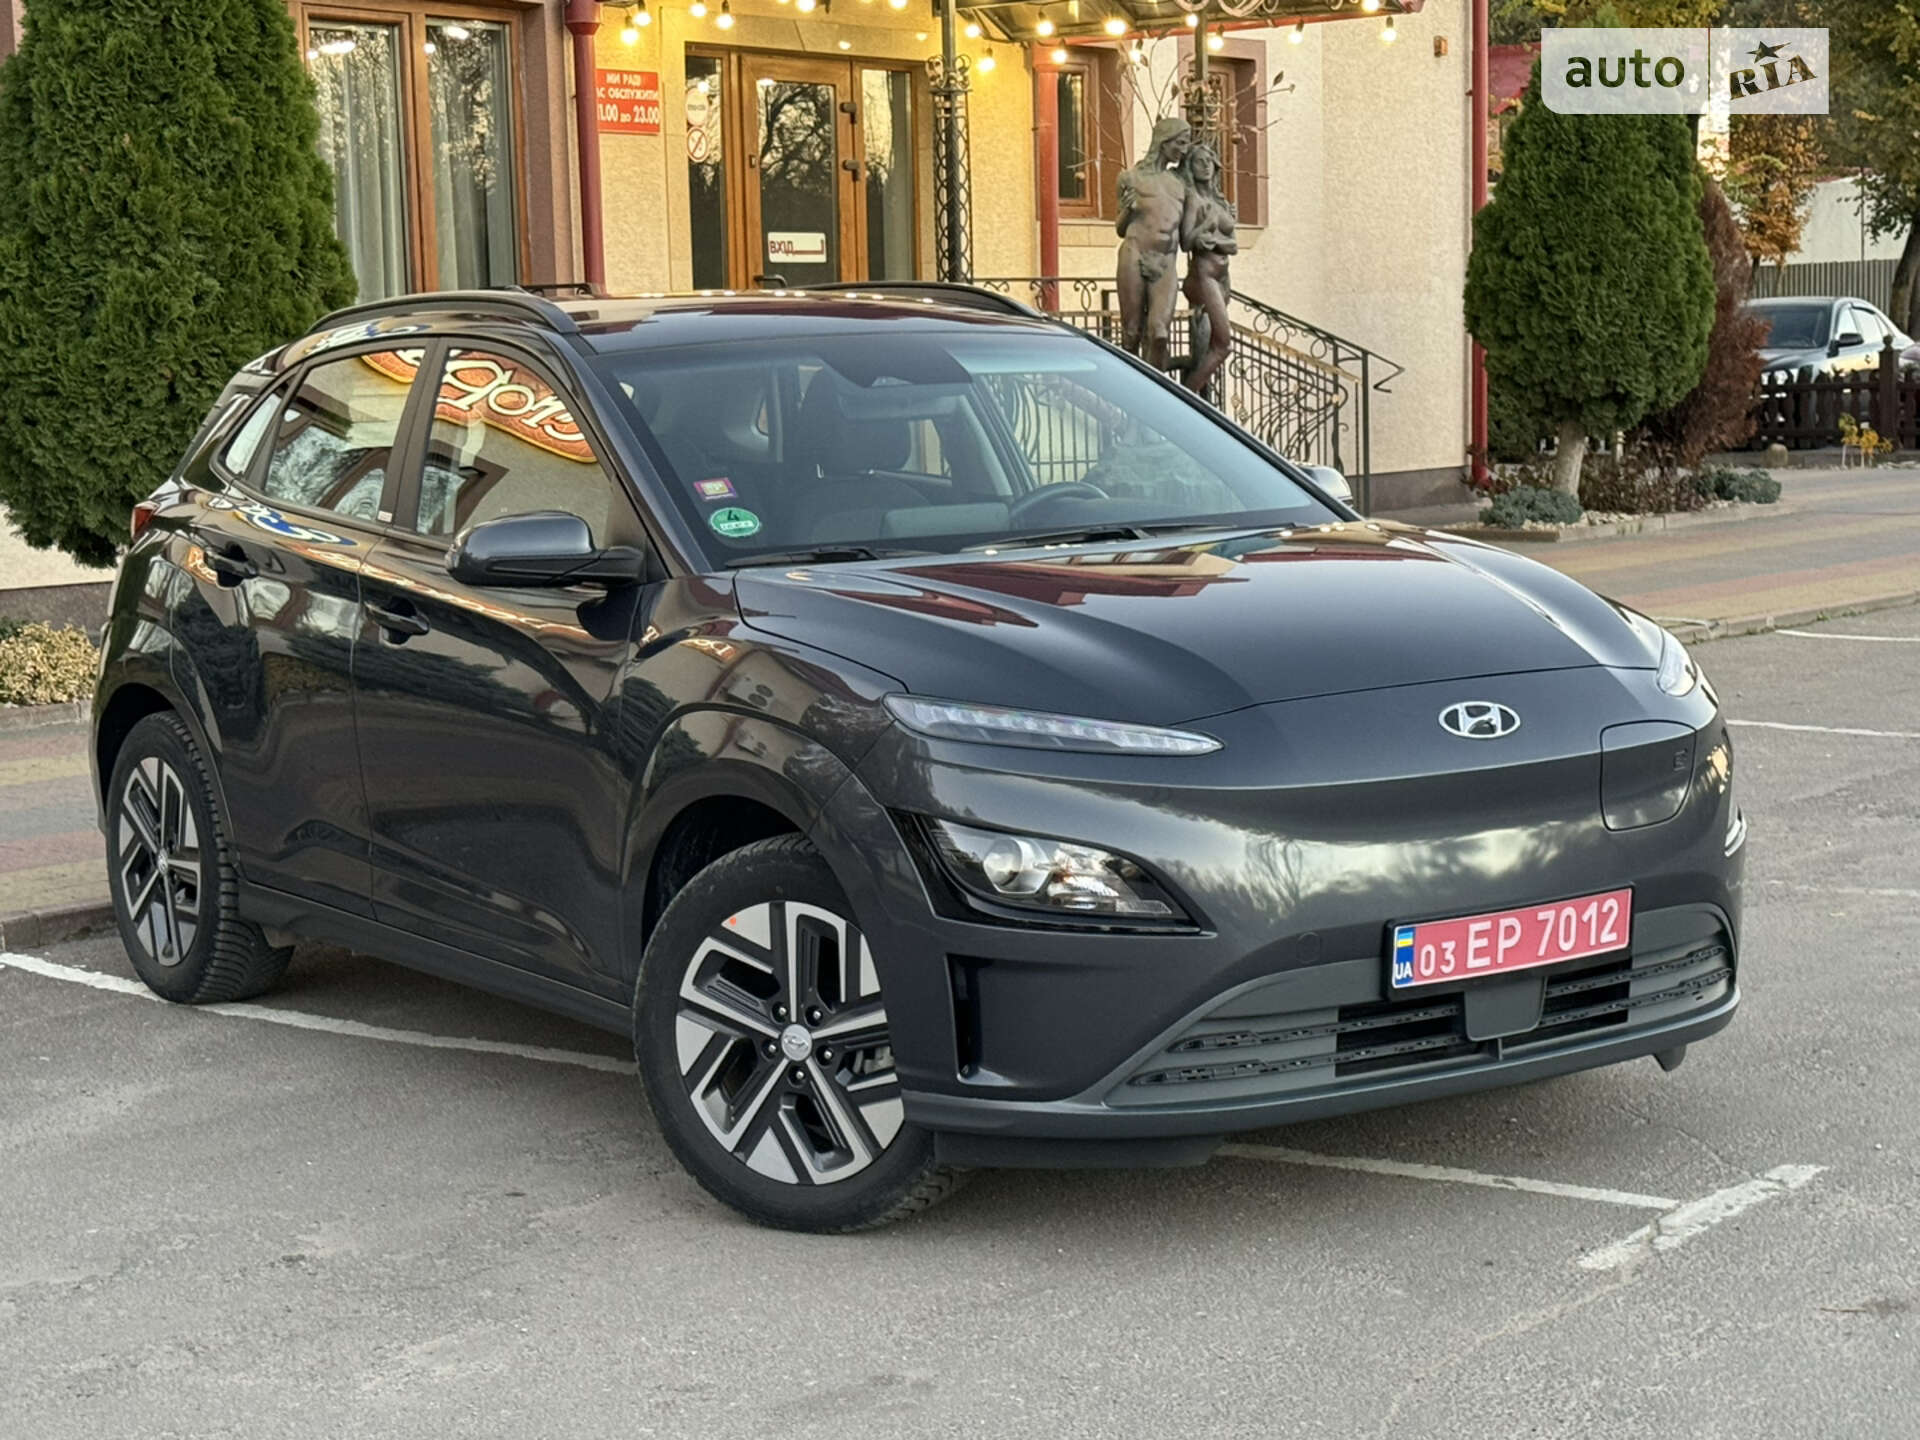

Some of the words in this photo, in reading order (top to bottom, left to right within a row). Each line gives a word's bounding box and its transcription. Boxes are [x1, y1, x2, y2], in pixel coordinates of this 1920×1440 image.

[633, 104, 659, 125] 23.00
[1419, 940, 1456, 977] 03
[1466, 916, 1522, 969] EP
[1537, 897, 1620, 957] 7012
[1395, 963, 1413, 979] UA
